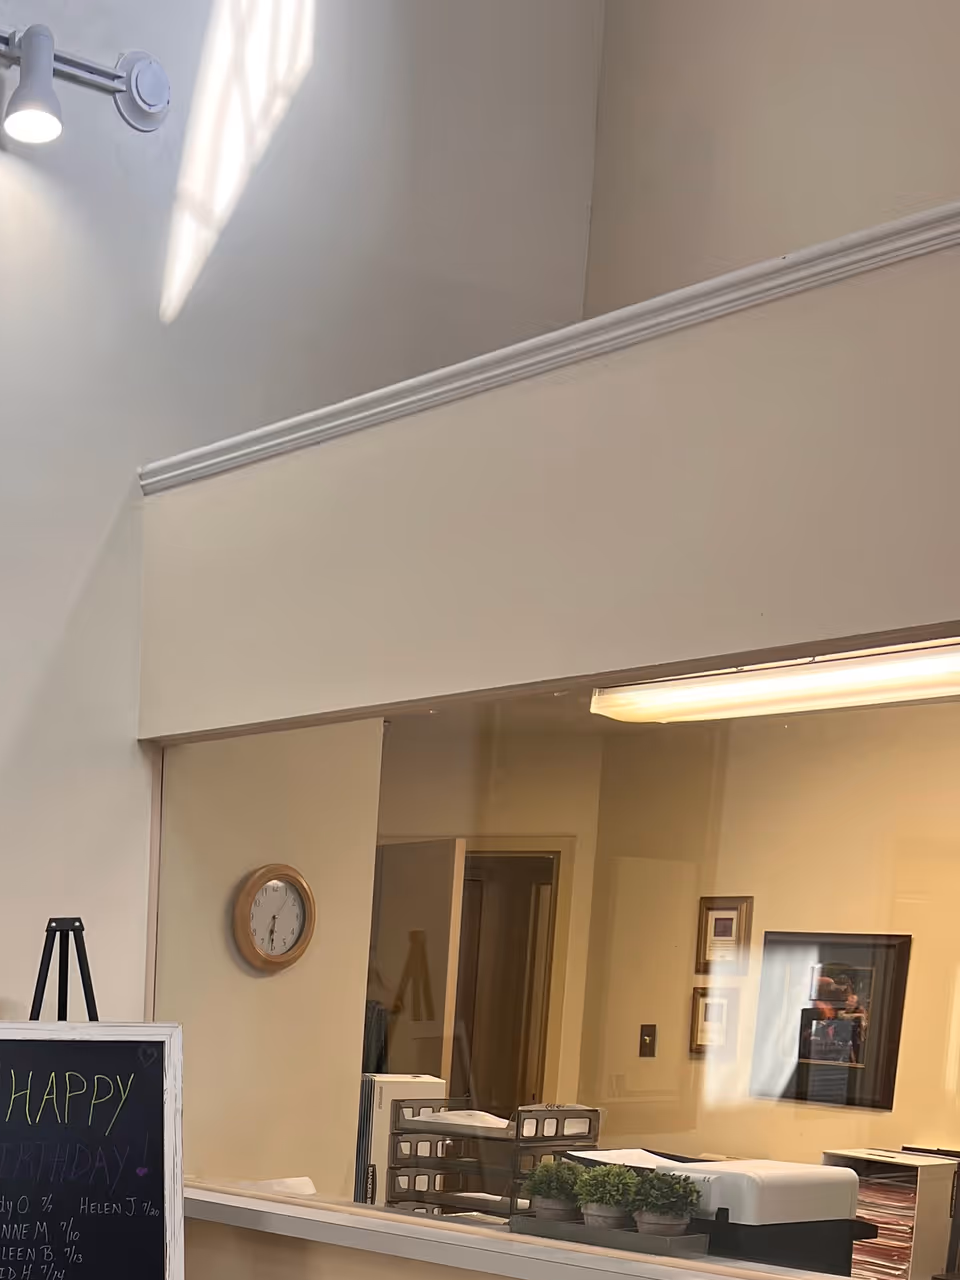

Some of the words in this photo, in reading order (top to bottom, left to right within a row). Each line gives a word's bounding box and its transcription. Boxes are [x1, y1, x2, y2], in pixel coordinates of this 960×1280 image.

[262, 887, 268, 896] 11
[5, 1068, 135, 1136] HAPPY
[41, 1193, 53, 1213] 7/7
[79, 1197, 122, 1215] HELEN
[142, 1200, 160, 1217] 7/20
[60, 1217, 80, 1243] 7/10
[64, 1245, 83, 1264] 7/13
